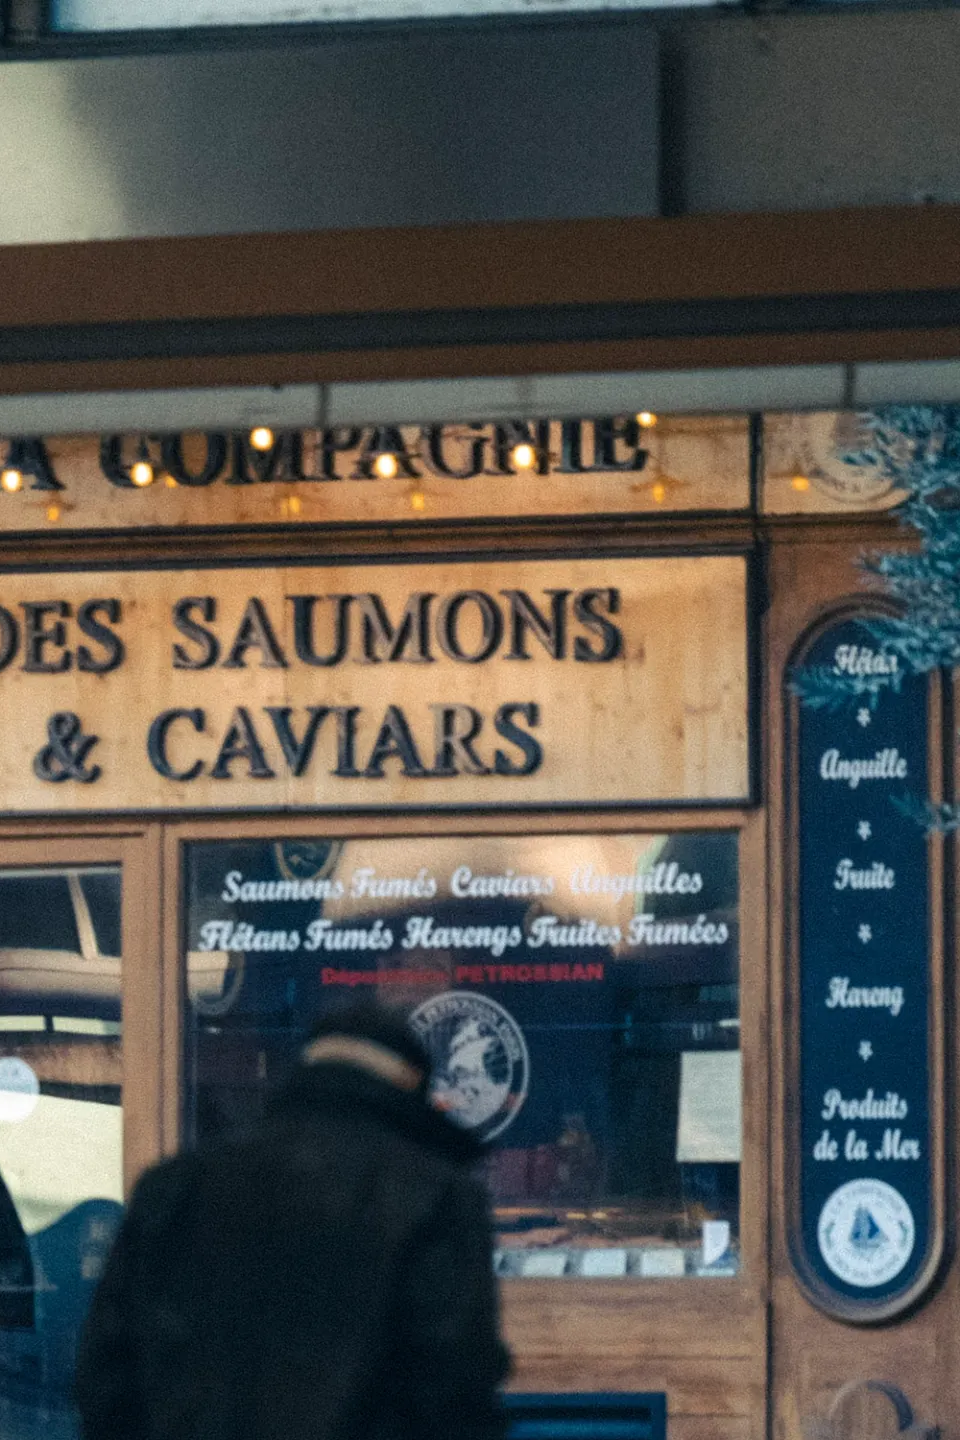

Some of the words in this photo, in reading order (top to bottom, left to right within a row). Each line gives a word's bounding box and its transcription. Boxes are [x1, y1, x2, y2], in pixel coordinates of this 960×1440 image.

[99, 415, 649, 489] COMPAGNIE
[172, 588, 626, 670] SAUMONS
[33, 710, 102, 785] &
[147, 702, 546, 782] CAVIARS
[820, 748, 908, 789] Anguille
[221, 870, 345, 903] Saumons
[350, 866, 438, 899] Fumés
[450, 864, 555, 898] Caviars
[569, 861, 704, 905] Anguilles
[834, 858, 896, 890] Truite
[197, 919, 301, 952] Flétans
[303, 918, 394, 951] Fumés
[401, 915, 522, 957] Harengs
[526, 915, 622, 948] Truites
[626, 912, 730, 946] Fumées
[825, 976, 905, 1017] Hareng
[821, 1088, 908, 1121] Produits
[813, 1129, 839, 1161] de
[844, 1129, 869, 1161] la
[874, 1128, 922, 1161] Mer
